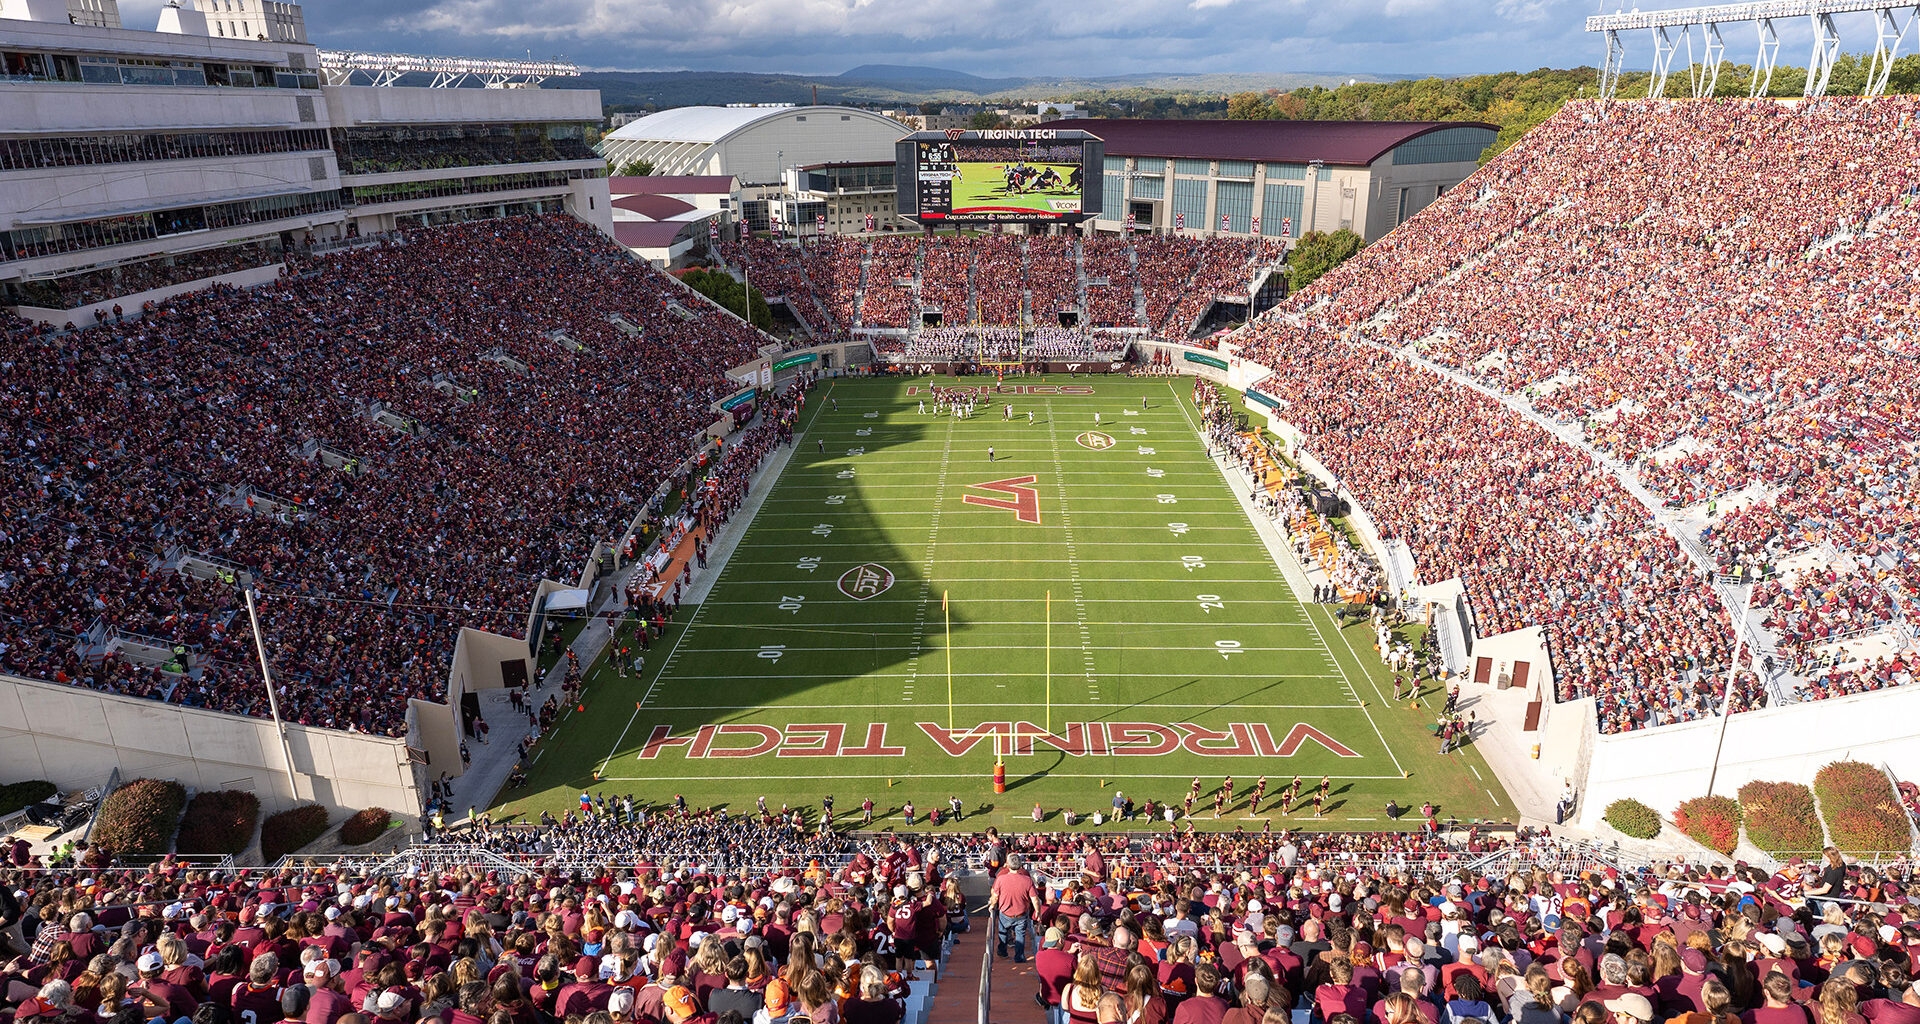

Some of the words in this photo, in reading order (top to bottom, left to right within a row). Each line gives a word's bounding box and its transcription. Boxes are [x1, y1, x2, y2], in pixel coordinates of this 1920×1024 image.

[944, 129, 965, 140] VT
[976, 129, 1026, 140] VIRGINIA
[1028, 129, 1057, 140] TECH
[1066, 363, 1081, 371] VT
[824, 495, 847, 505] 50
[1156, 494, 1178, 504] 50
[811, 523, 834, 535] 40
[1167, 522, 1190, 534] 40
[796, 556, 822, 569] 30
[1181, 555, 1206, 569] 30
[858, 568, 881, 594] ACC
[778, 595, 806, 610] 20
[1196, 594, 1225, 609] 20
[757, 644, 787, 658] 10
[1214, 640, 1245, 654] 10
[636, 723, 907, 760] TECH
[915, 721, 1364, 758] VIRGINIA
[895, 904, 911, 919] 25
[1541, 897, 1561, 915] 78
